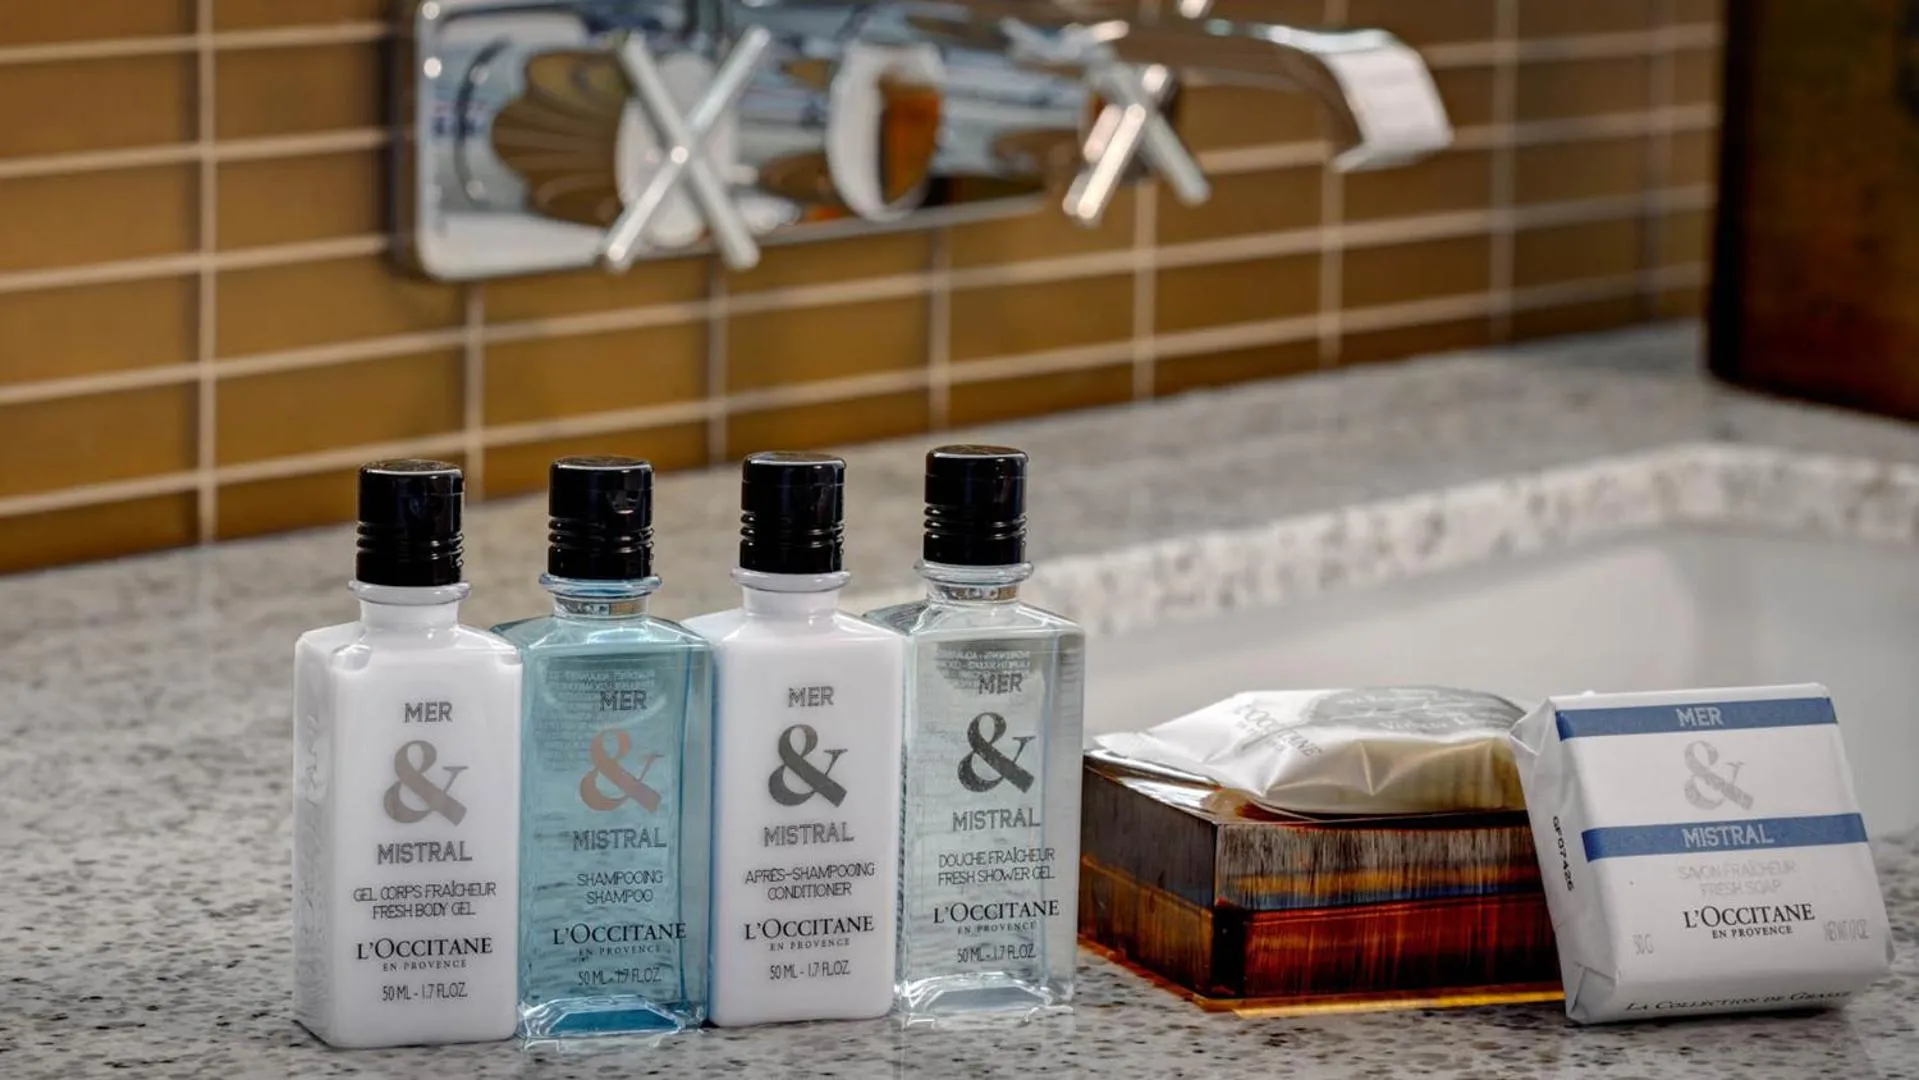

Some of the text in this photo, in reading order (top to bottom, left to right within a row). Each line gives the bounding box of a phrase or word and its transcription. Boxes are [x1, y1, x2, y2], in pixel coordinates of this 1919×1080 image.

[978, 672, 1022, 694] MER
[599, 690, 647, 711] MER
[788, 686, 834, 707] MER
[404, 702, 453, 723] MER
[1676, 707, 1724, 727] MER
[957, 712, 1035, 794] &
[580, 728, 664, 813] &
[768, 725, 848, 807] &
[1684, 740, 1755, 811] &
[383, 740, 469, 827] &
[952, 807, 1041, 831] MISTRAL
[572, 828, 667, 851] MISTRAL
[764, 822, 854, 847] MISTRAL
[1681, 823, 1775, 848] MISTRAL
[378, 841, 473, 865] MISTRAL
[938, 851, 986, 868] DOUCHE
[577, 870, 664, 887] SHAMPOOING
[938, 865, 1056, 886] FRESH SHOWER GEL
[353, 887, 377, 901] GEL
[380, 884, 422, 901] CORPS
[586, 888, 654, 905] SHAMPOO
[768, 881, 852, 901] CONDITIONER
[372, 901, 476, 920] FRESH BODY GEL
[933, 900, 1060, 924] L'OCCITANE
[1683, 903, 1815, 929] L'OCCITANE
[553, 922, 687, 945] L'OCCITANE
[744, 915, 875, 940] L'OCCITANE
[957, 921, 1037, 934] EN PROVENCE
[1712, 925, 1793, 940] EN PROVENCE
[356, 937, 493, 960] L'OCCITANE
[770, 938, 850, 951] EN PROVENCE
[383, 959, 467, 972] EN PROVENCE
[770, 964, 781, 980] 50
[783, 964, 798, 979] ML
[382, 985, 395, 1001] 50
[397, 984, 412, 1000] ML
